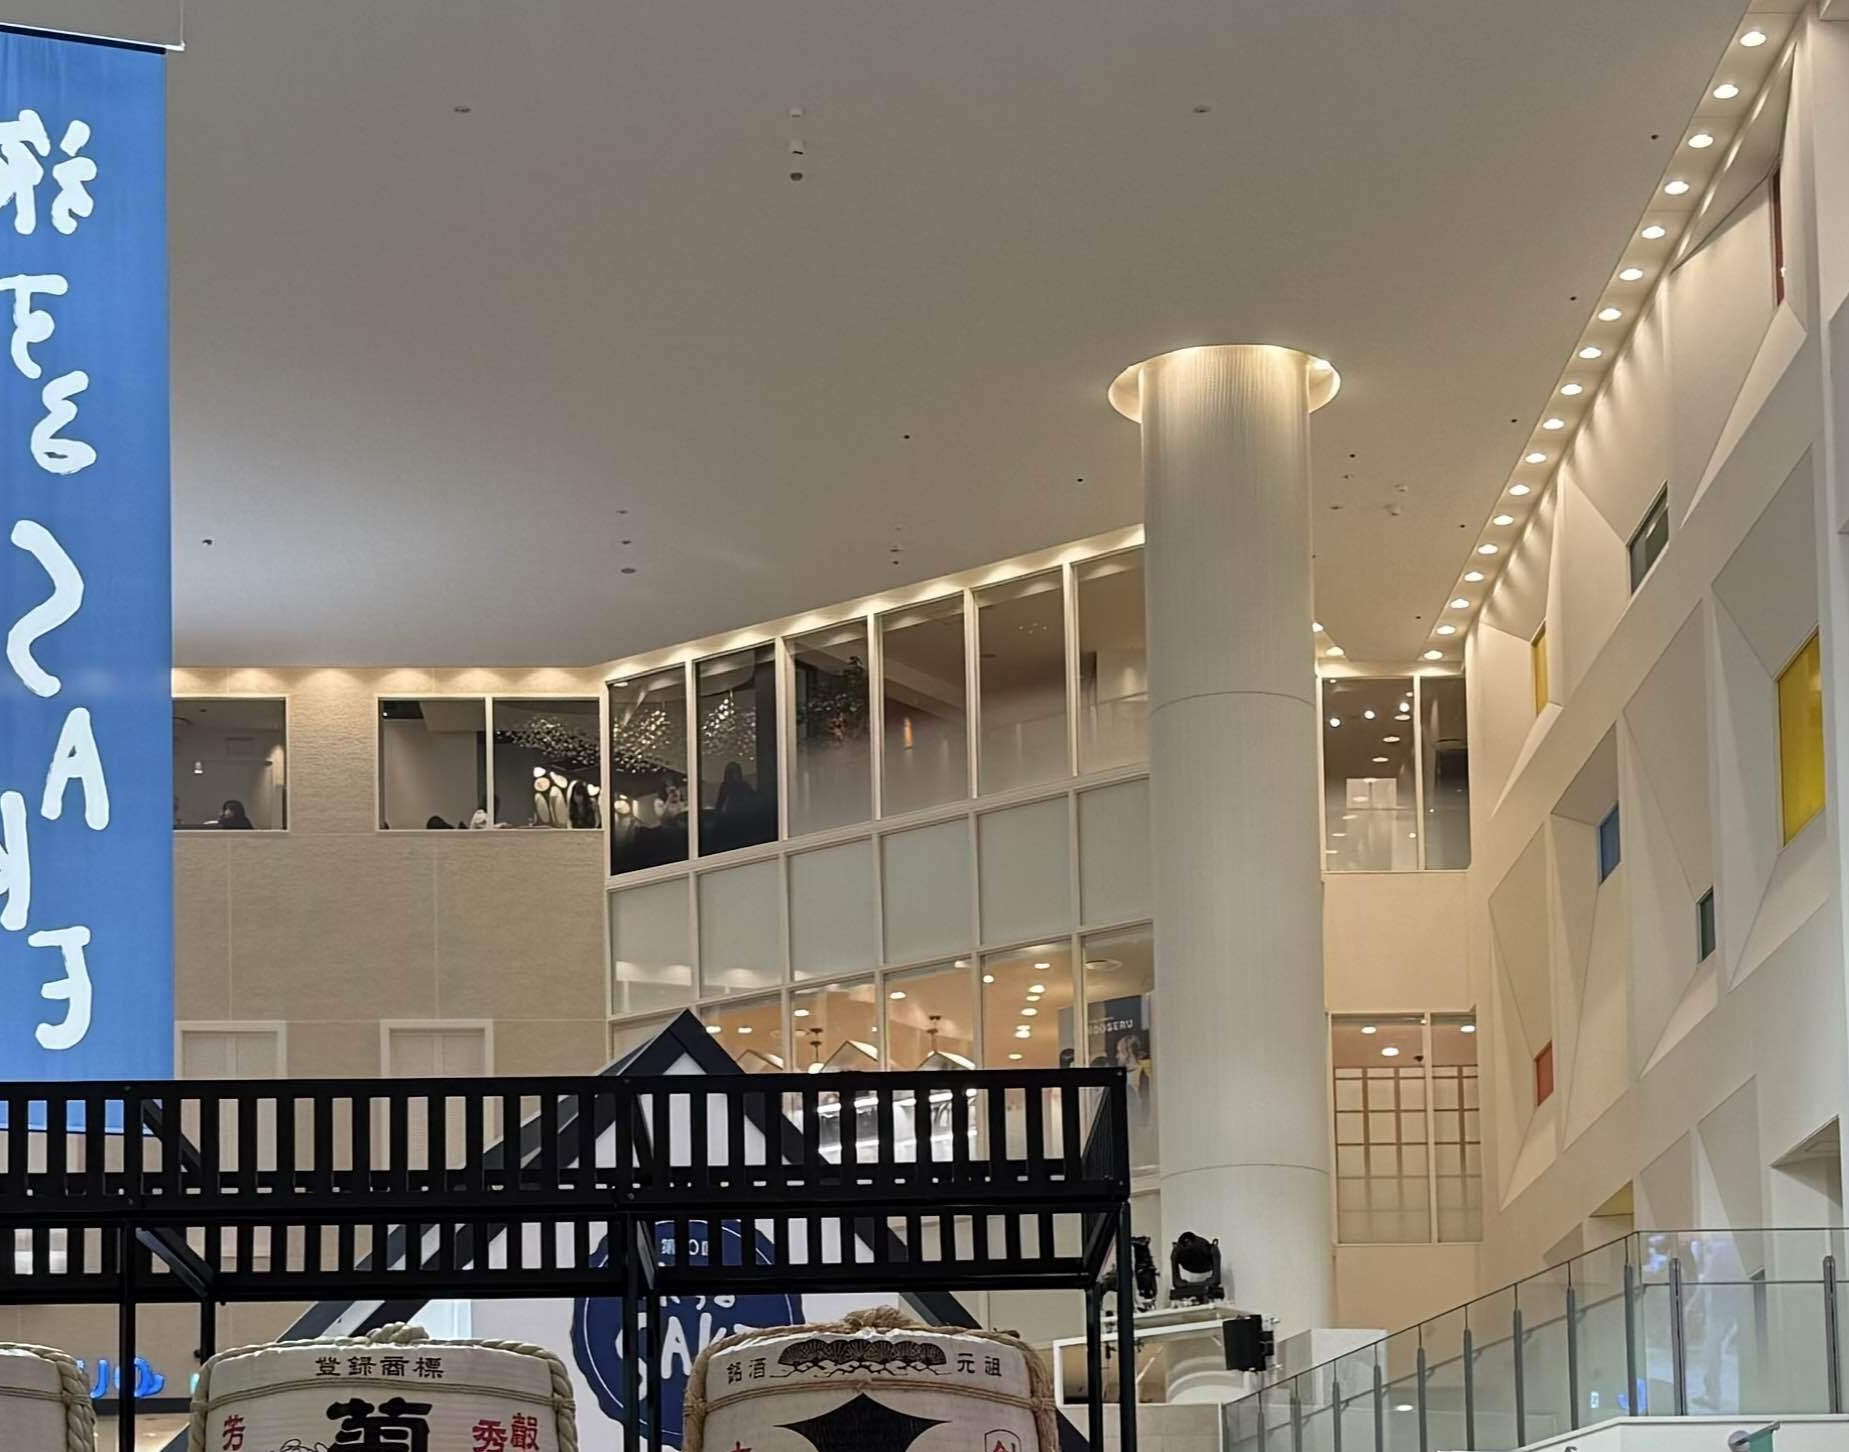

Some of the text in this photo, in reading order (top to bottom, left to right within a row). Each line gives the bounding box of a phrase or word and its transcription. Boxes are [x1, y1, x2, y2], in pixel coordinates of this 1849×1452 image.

[315, 1356, 444, 1379] 登録商標
[958, 1352, 1002, 1377] 元祖
